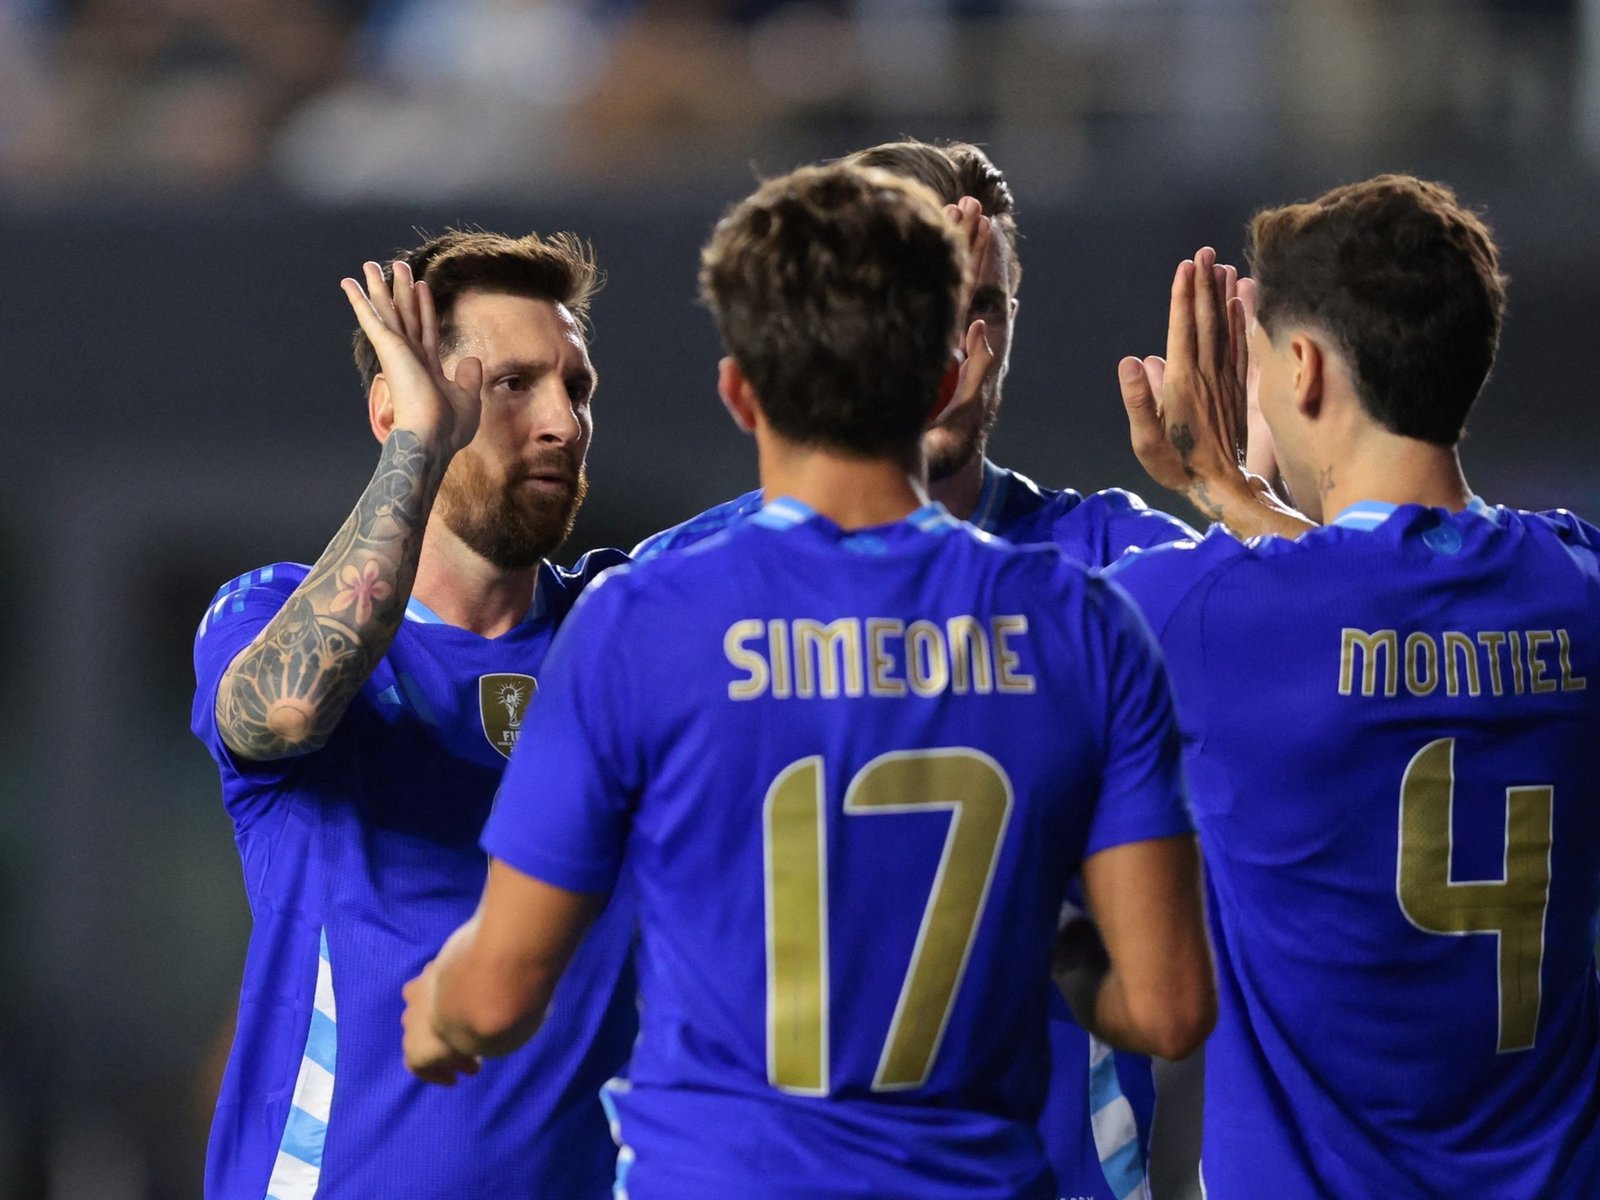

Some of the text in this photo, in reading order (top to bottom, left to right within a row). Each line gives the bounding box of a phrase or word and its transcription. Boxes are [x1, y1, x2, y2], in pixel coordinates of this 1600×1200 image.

[723, 614, 1037, 702] SIMEONE
[1337, 628, 1587, 697] MONTIEL
[502, 730, 521, 742] FIF
[762, 746, 1015, 1098] 17
[1396, 737, 1554, 1055] 4
